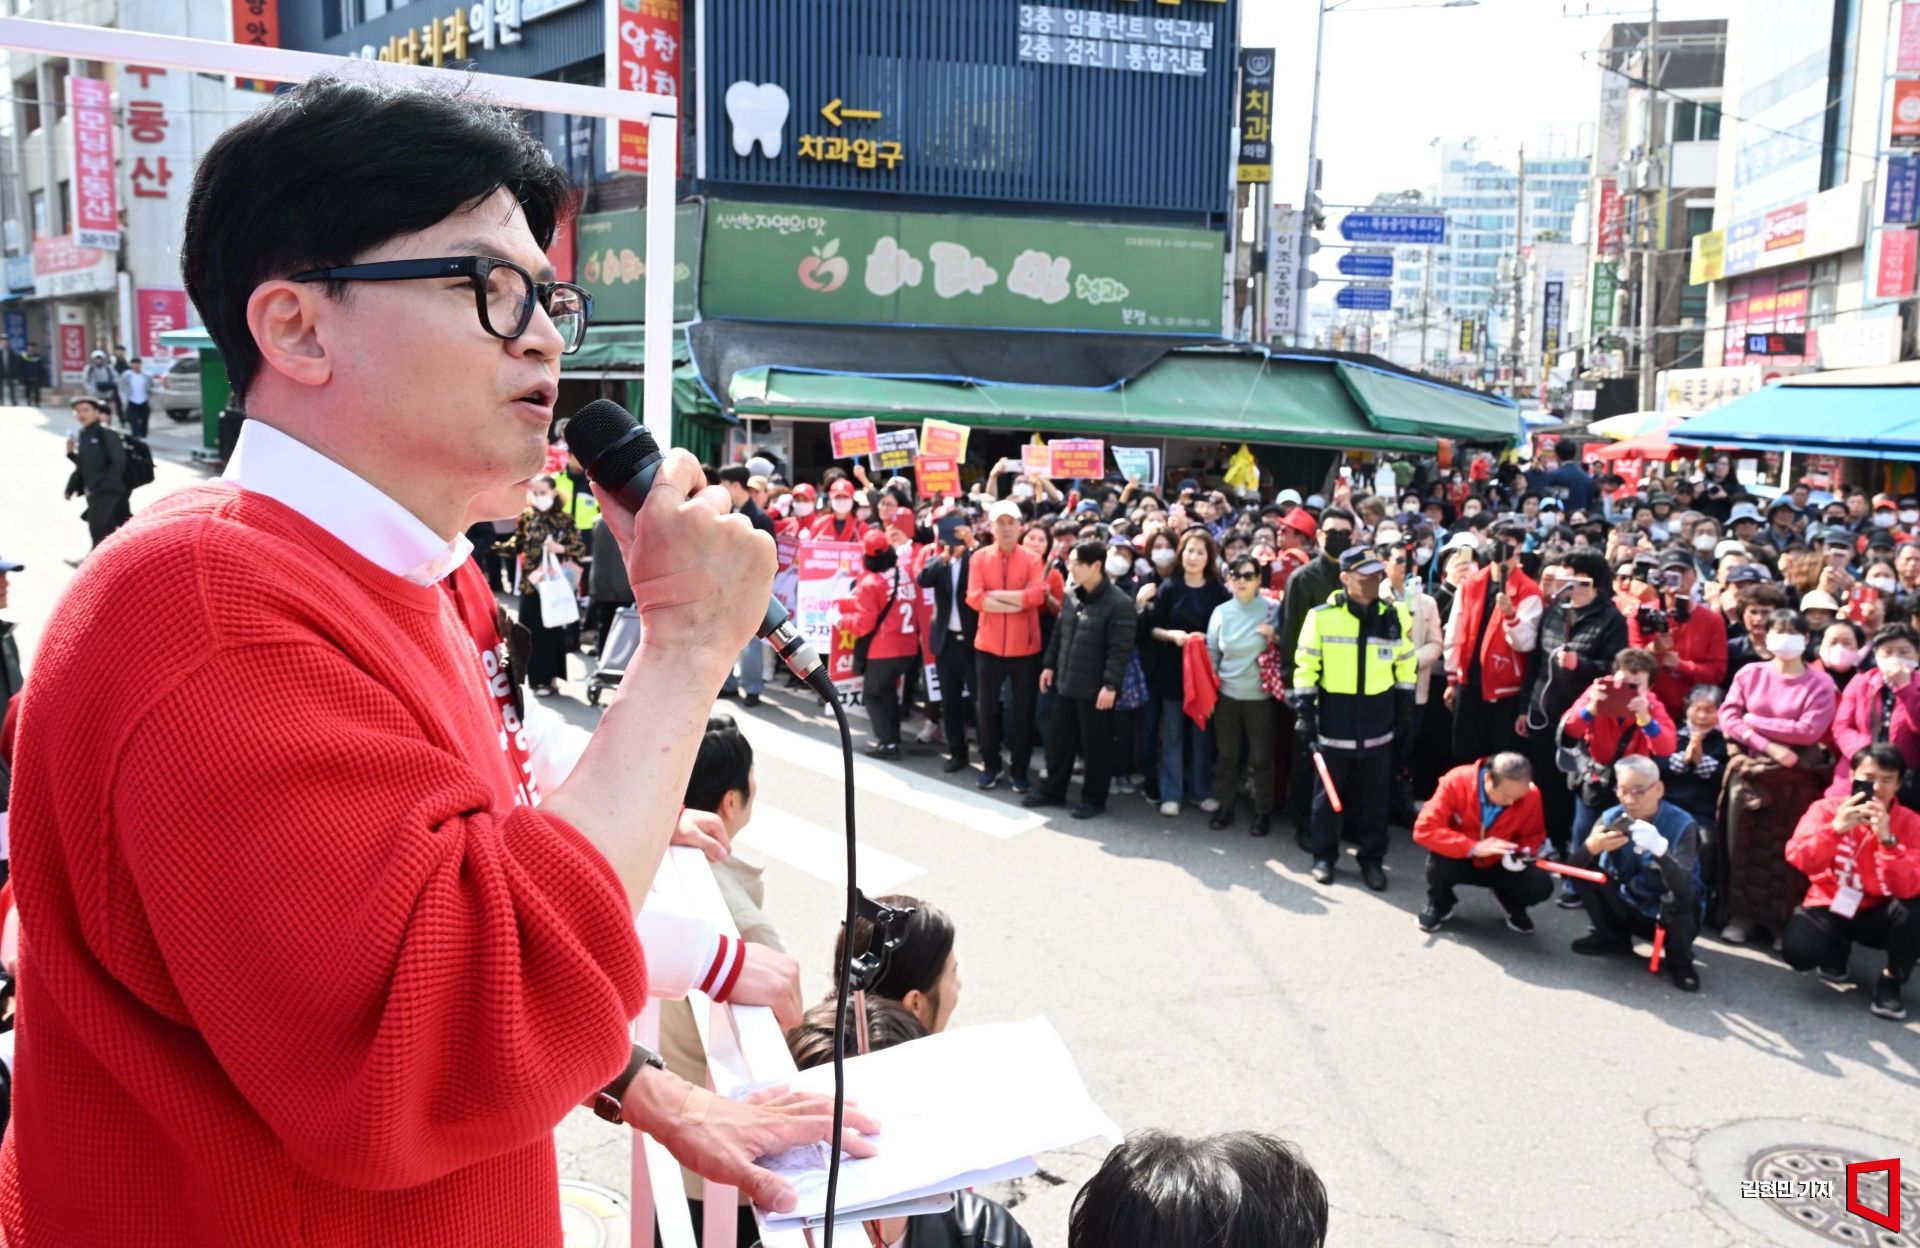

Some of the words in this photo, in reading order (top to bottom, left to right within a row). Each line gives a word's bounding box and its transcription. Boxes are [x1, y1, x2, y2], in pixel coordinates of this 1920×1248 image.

[1019, 5, 1055, 34] 3층
[1064, 9, 1147, 40] 임플란트
[1154, 18, 1214, 49] 연구실
[1019, 34, 1055, 63] 2층
[1064, 38, 1104, 67] 검진
[1125, 44, 1206, 73] 통합진료
[1244, 89, 1271, 142] 치과
[798, 134, 904, 170] 치과입구
[807, 215, 828, 236] 맛
[900, 603, 914, 633] 2
